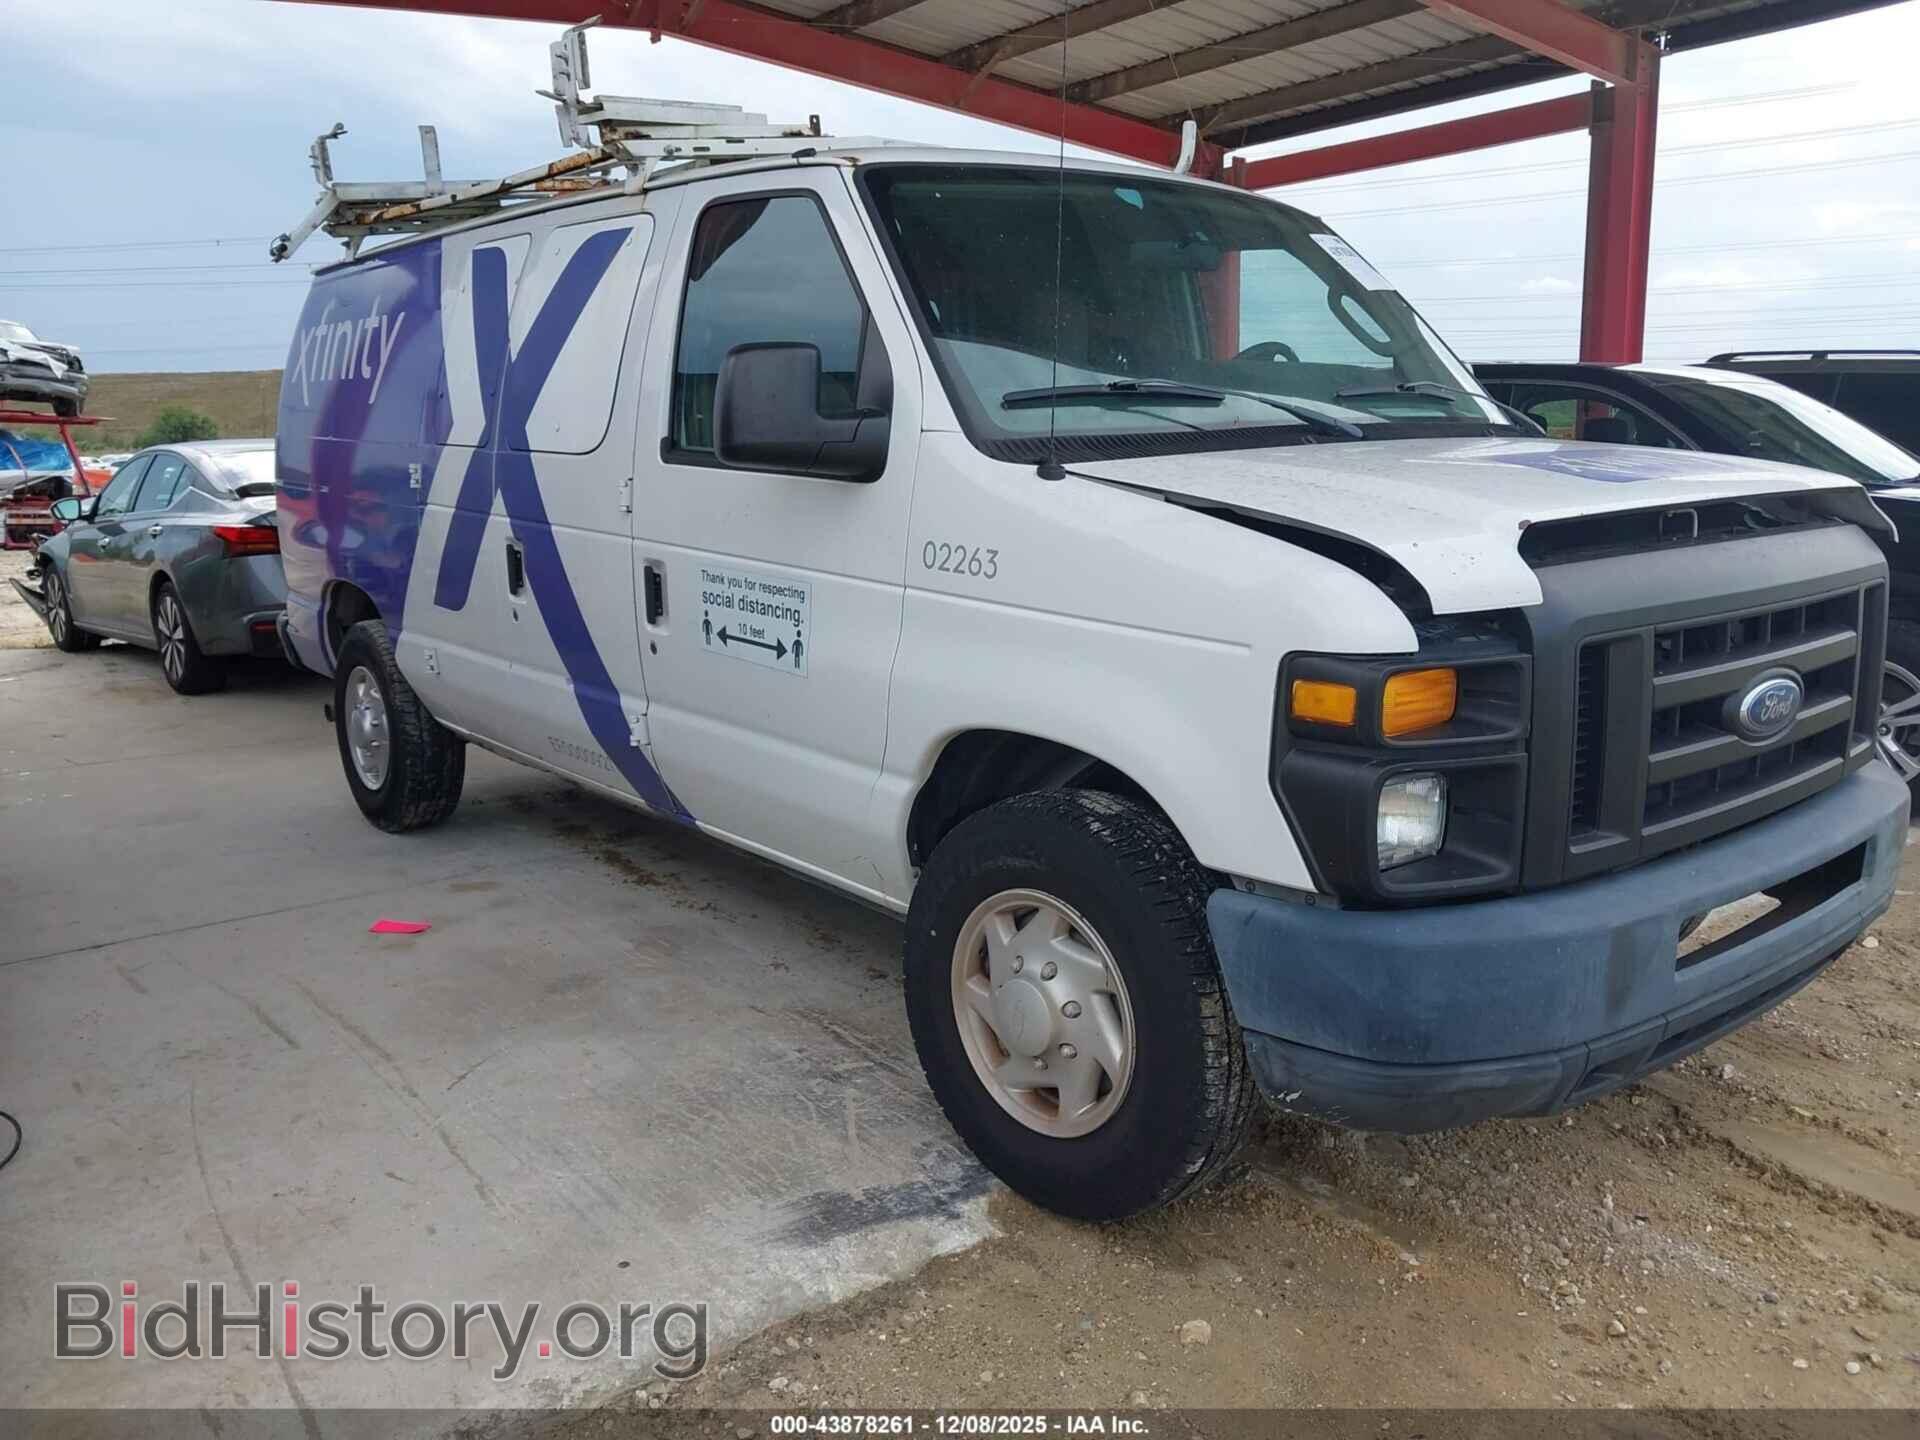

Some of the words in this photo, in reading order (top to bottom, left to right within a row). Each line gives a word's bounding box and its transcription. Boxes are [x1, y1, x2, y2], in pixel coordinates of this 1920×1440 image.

[291, 295, 405, 407] xfinity
[922, 540, 999, 580] 02263
[701, 569, 726, 585] Thank
[727, 577, 743, 590] you
[744, 577, 757, 592] for
[759, 582, 805, 604] respecting
[702, 590, 735, 609] social
[738, 595, 804, 628] distancing.
[738, 622, 748, 636] 10
[749, 624, 766, 640] feet
[1760, 688, 1794, 722] Ford
